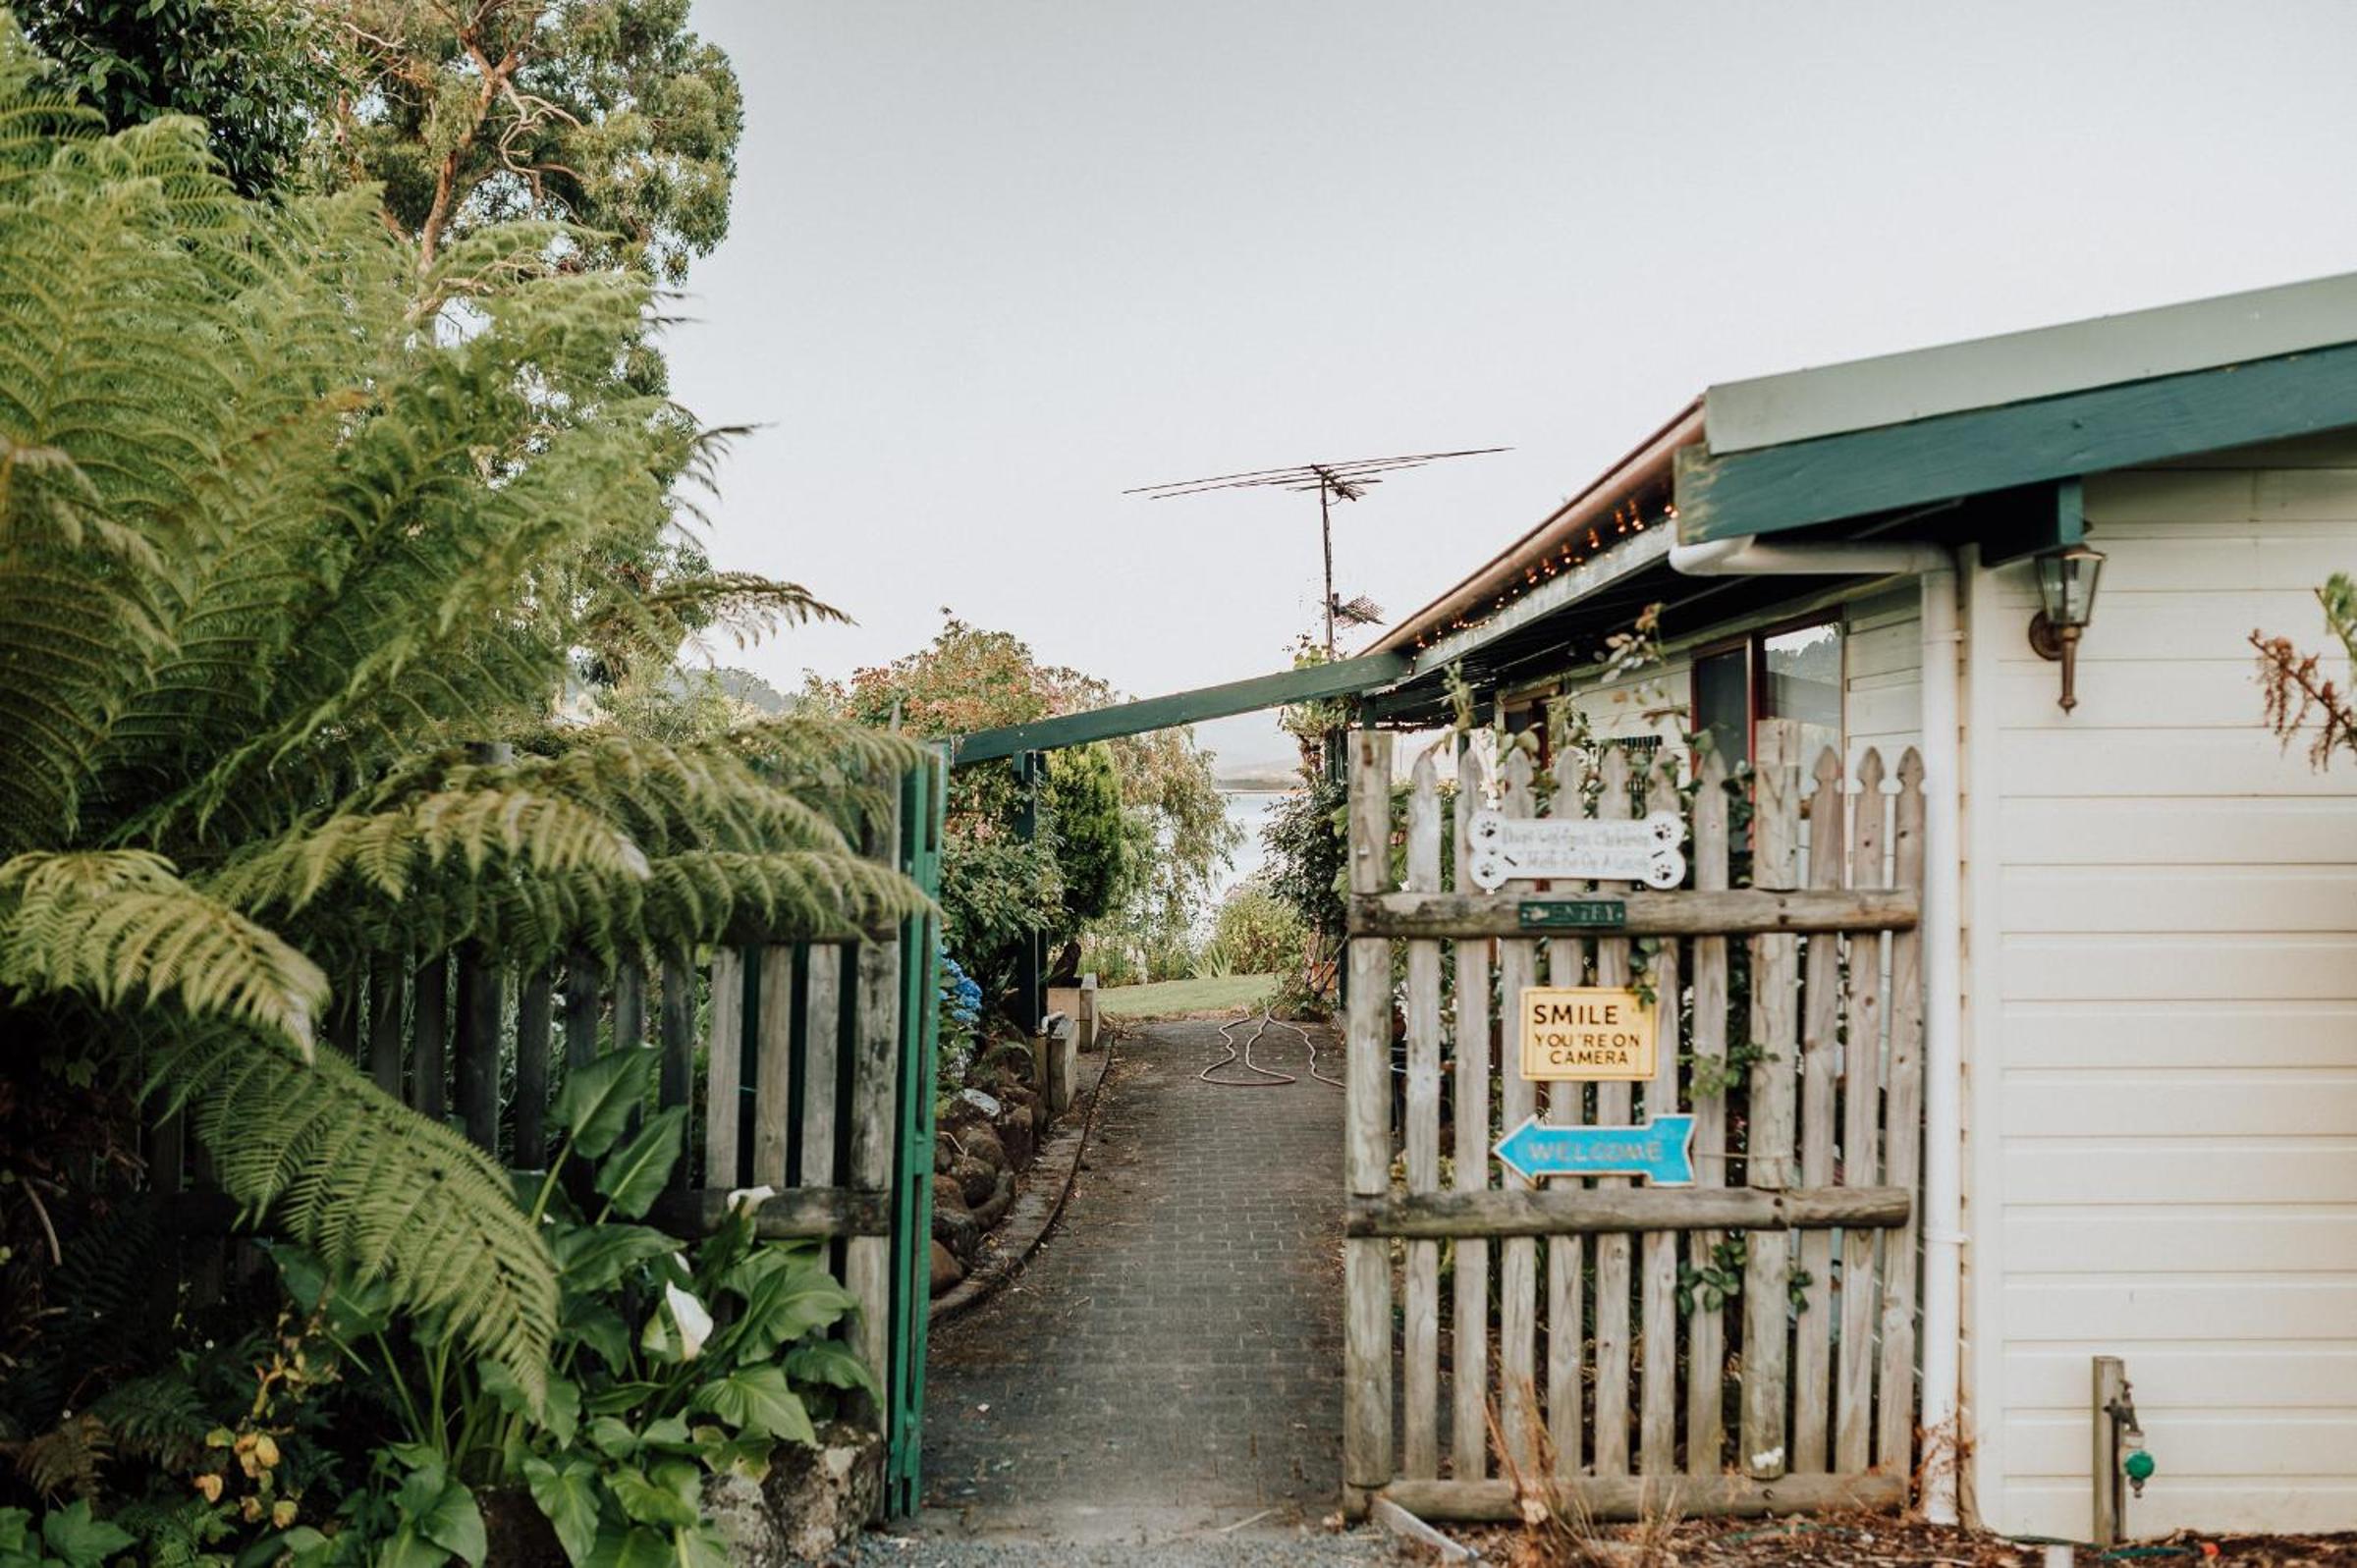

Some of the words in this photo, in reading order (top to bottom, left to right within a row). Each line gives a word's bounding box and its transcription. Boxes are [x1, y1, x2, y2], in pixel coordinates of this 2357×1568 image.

[1533, 1004, 1618, 1025] SMILE
[1612, 1033, 1640, 1048] ON
[1550, 1050, 1629, 1064] CAMERA
[1528, 1140, 1663, 1162] WELCOME
